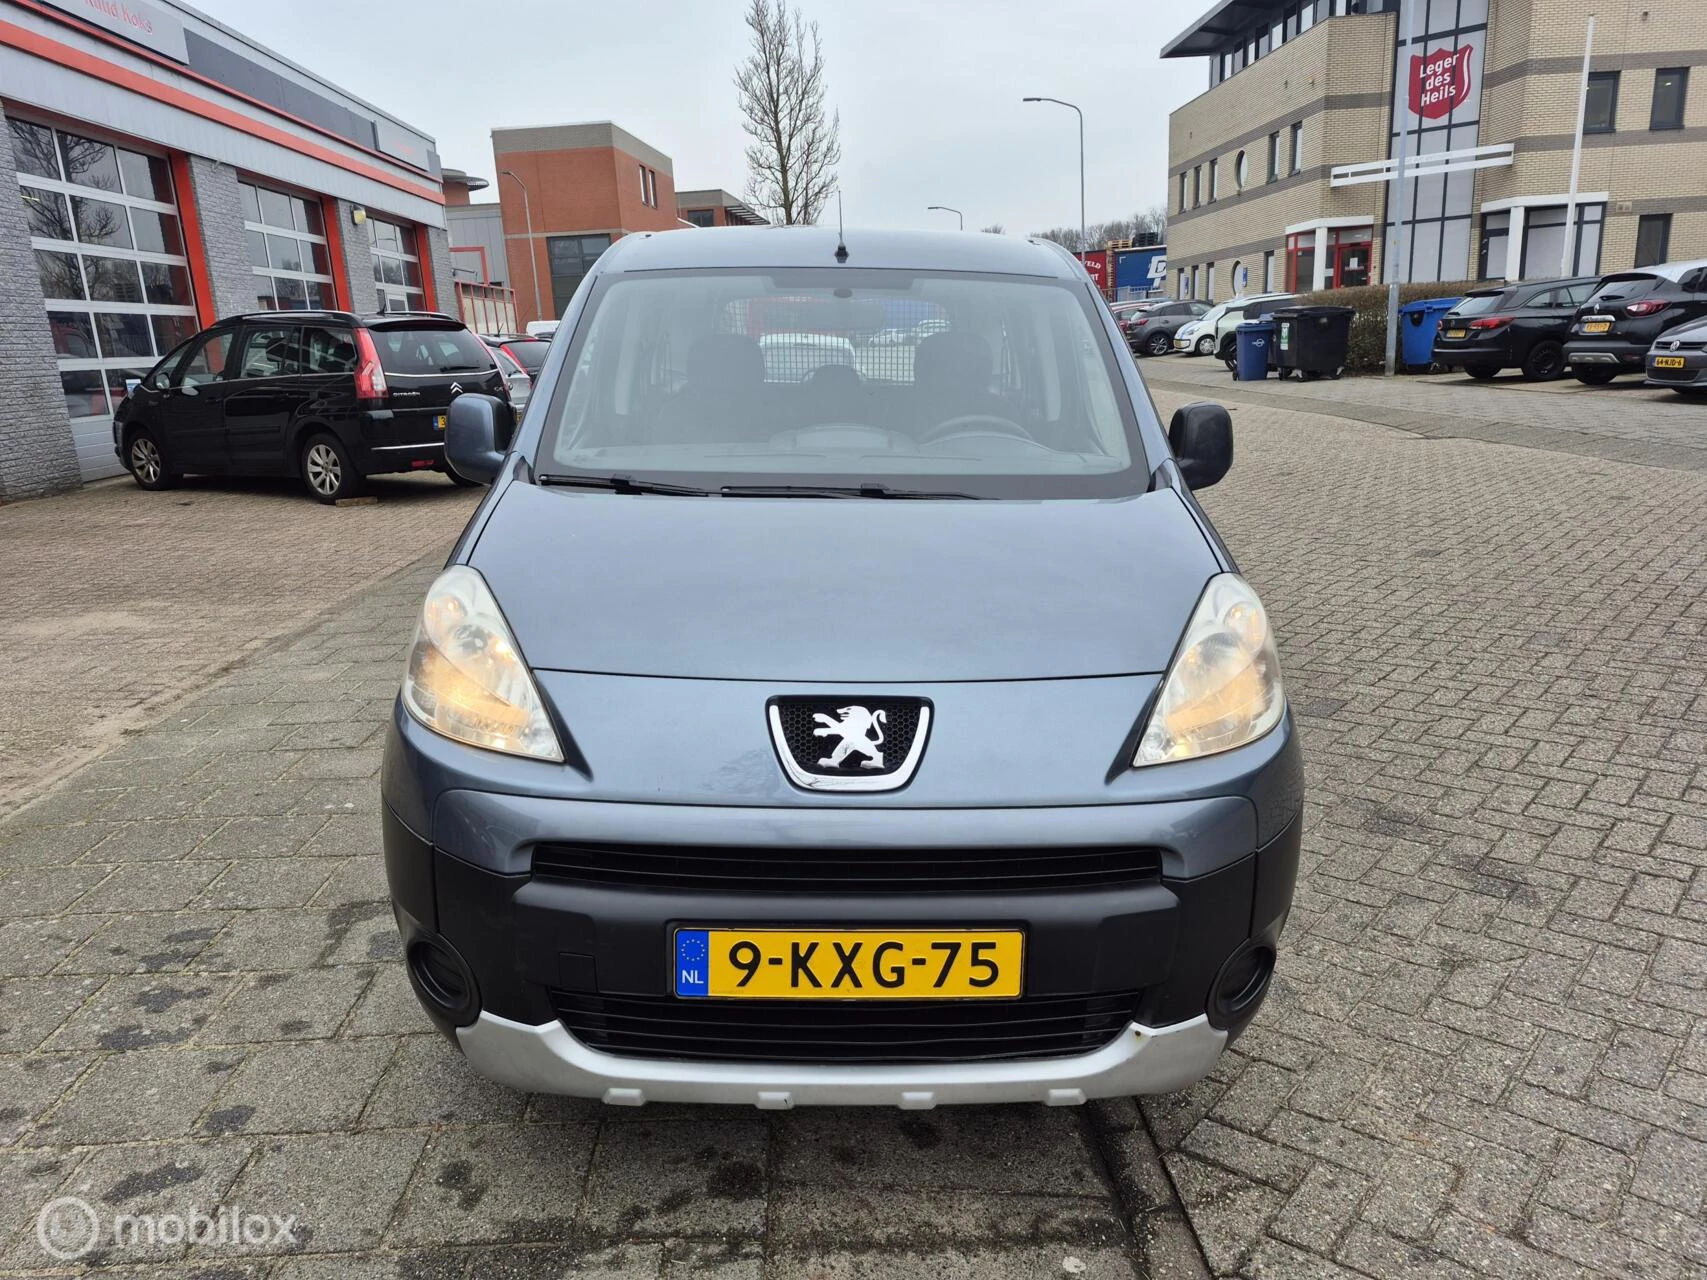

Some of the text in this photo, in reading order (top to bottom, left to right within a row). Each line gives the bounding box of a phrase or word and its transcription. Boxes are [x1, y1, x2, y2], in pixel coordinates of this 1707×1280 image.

[1420, 54, 1459, 78] Leger
[1425, 73, 1451, 90] des
[1421, 85, 1456, 107] Heils
[681, 940, 1000, 989] NL 9-KXG-75
